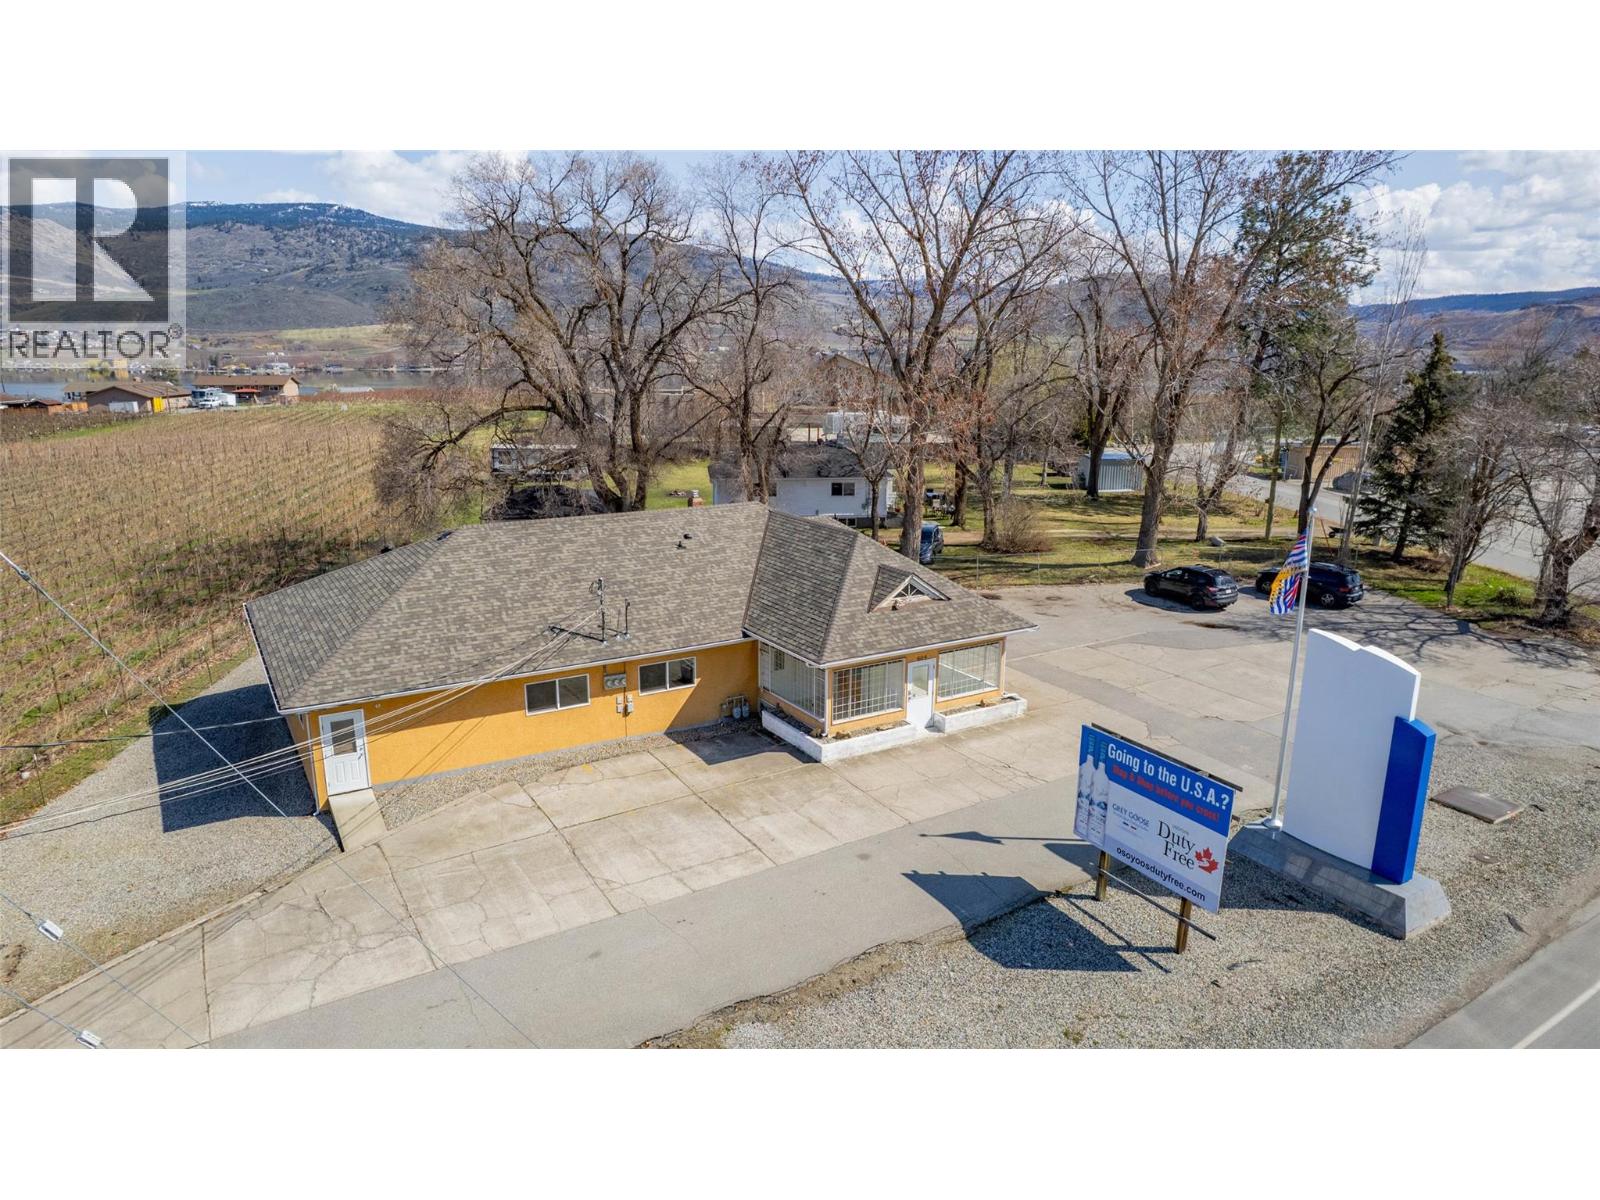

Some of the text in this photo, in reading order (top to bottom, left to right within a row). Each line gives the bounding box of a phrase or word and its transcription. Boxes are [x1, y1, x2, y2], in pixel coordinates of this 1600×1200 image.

[1108, 743, 1230, 810] Going to the U.S.A.?
[1157, 820, 1196, 855] Duty
[1163, 839, 1195, 870] Free
[1116, 847, 1206, 902] osoyoosdutyfree.com
